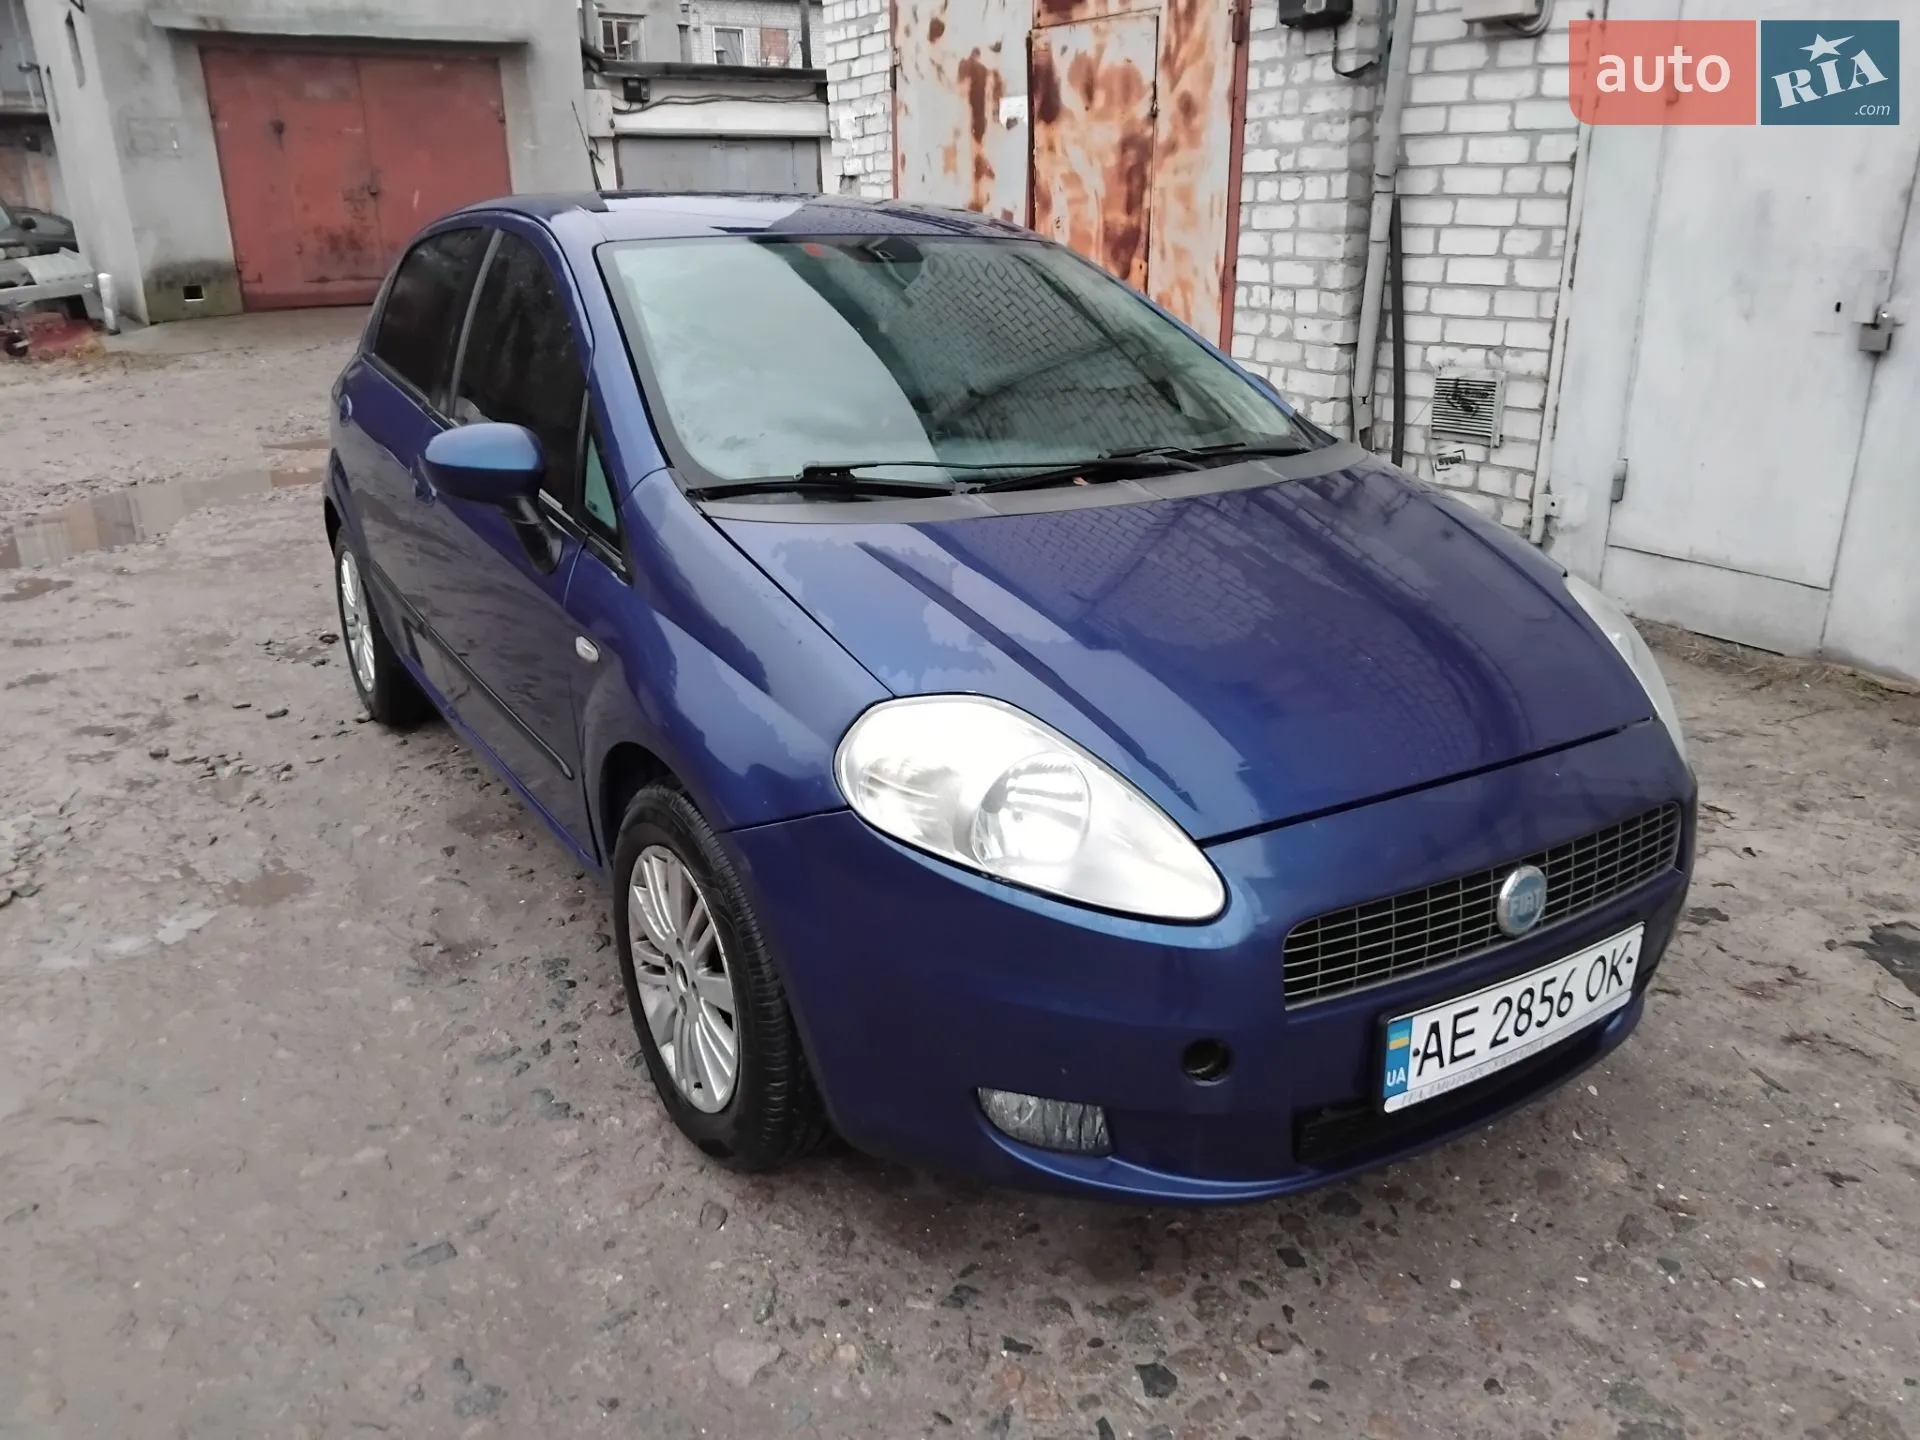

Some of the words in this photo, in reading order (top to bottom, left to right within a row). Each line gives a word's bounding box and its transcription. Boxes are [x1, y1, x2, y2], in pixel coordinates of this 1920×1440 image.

[1417, 1006, 1479, 1076] AE
[1489, 967, 1577, 1049] 2856
[1586, 940, 1631, 1002] OK
[1387, 1067, 1406, 1087] UA
